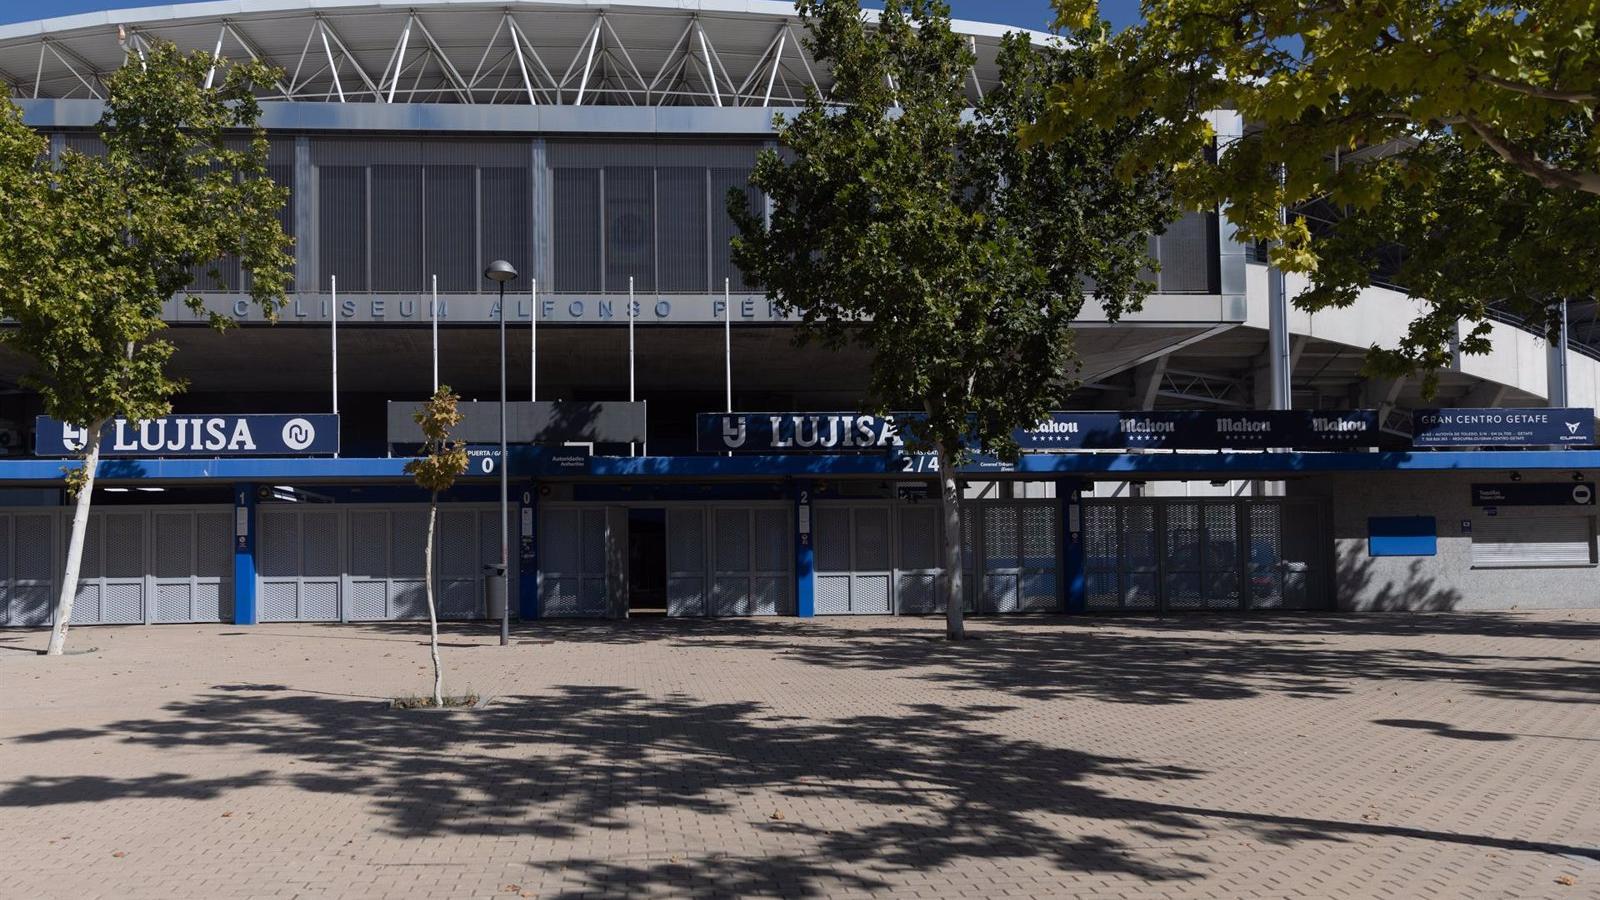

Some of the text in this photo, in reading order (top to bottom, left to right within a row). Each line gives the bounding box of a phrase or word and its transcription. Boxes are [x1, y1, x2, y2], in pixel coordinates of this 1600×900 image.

[488, 300, 672, 317] ALFONSO
[1120, 418, 1175, 433] Mahou
[1216, 417, 1271, 432] Mahou
[1312, 417, 1367, 432] Mahou
[1421, 414, 1548, 424] GRAN CENTRO GETAFE
[113, 418, 257, 450] LUJISA
[770, 415, 904, 447] LUJISA
[481, 457, 494, 473] 0
[902, 456, 914, 472] 2
[927, 456, 940, 472] 4
[800, 490, 809, 504] 2
